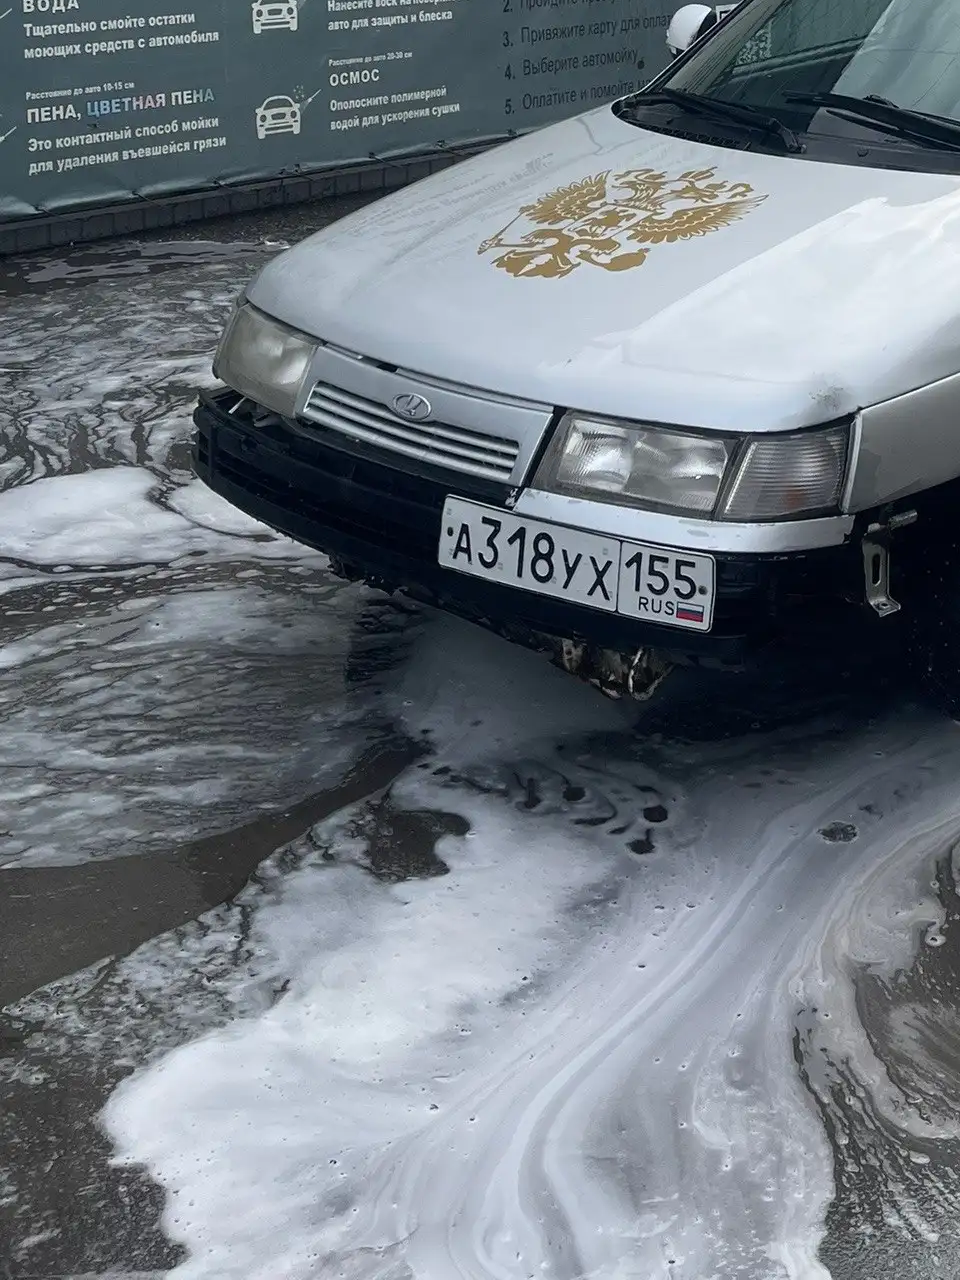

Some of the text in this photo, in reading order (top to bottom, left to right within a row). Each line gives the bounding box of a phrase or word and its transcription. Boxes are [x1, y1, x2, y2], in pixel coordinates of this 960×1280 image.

[328, 0, 373, 11] Нанесите
[24, 14, 195, 37] Тщательно смойте остатки
[328, 11, 452, 30] авто для защиты блеска
[503, 17, 640, 47] 3. Привяжите карту для
[25, 31, 218, 58] моющих средств с автомобиля
[505, 48, 638, 80] 4. Выберите автомойку
[329, 69, 380, 86] ОСМОС
[27, 89, 213, 123] ПЕНА, ЦВЕТНАЯ ПЕНА
[330, 86, 446, 111] Ополосните полимерной
[505, 91, 576, 115] 5. Оплатите
[331, 104, 459, 130] водой для ускорения сушки
[29, 117, 218, 151] Это контактный способ мойки
[29, 137, 226, 176] для удаления въевшейся грязи
[625, 551, 697, 600] 155
[638, 596, 675, 616] RUS
